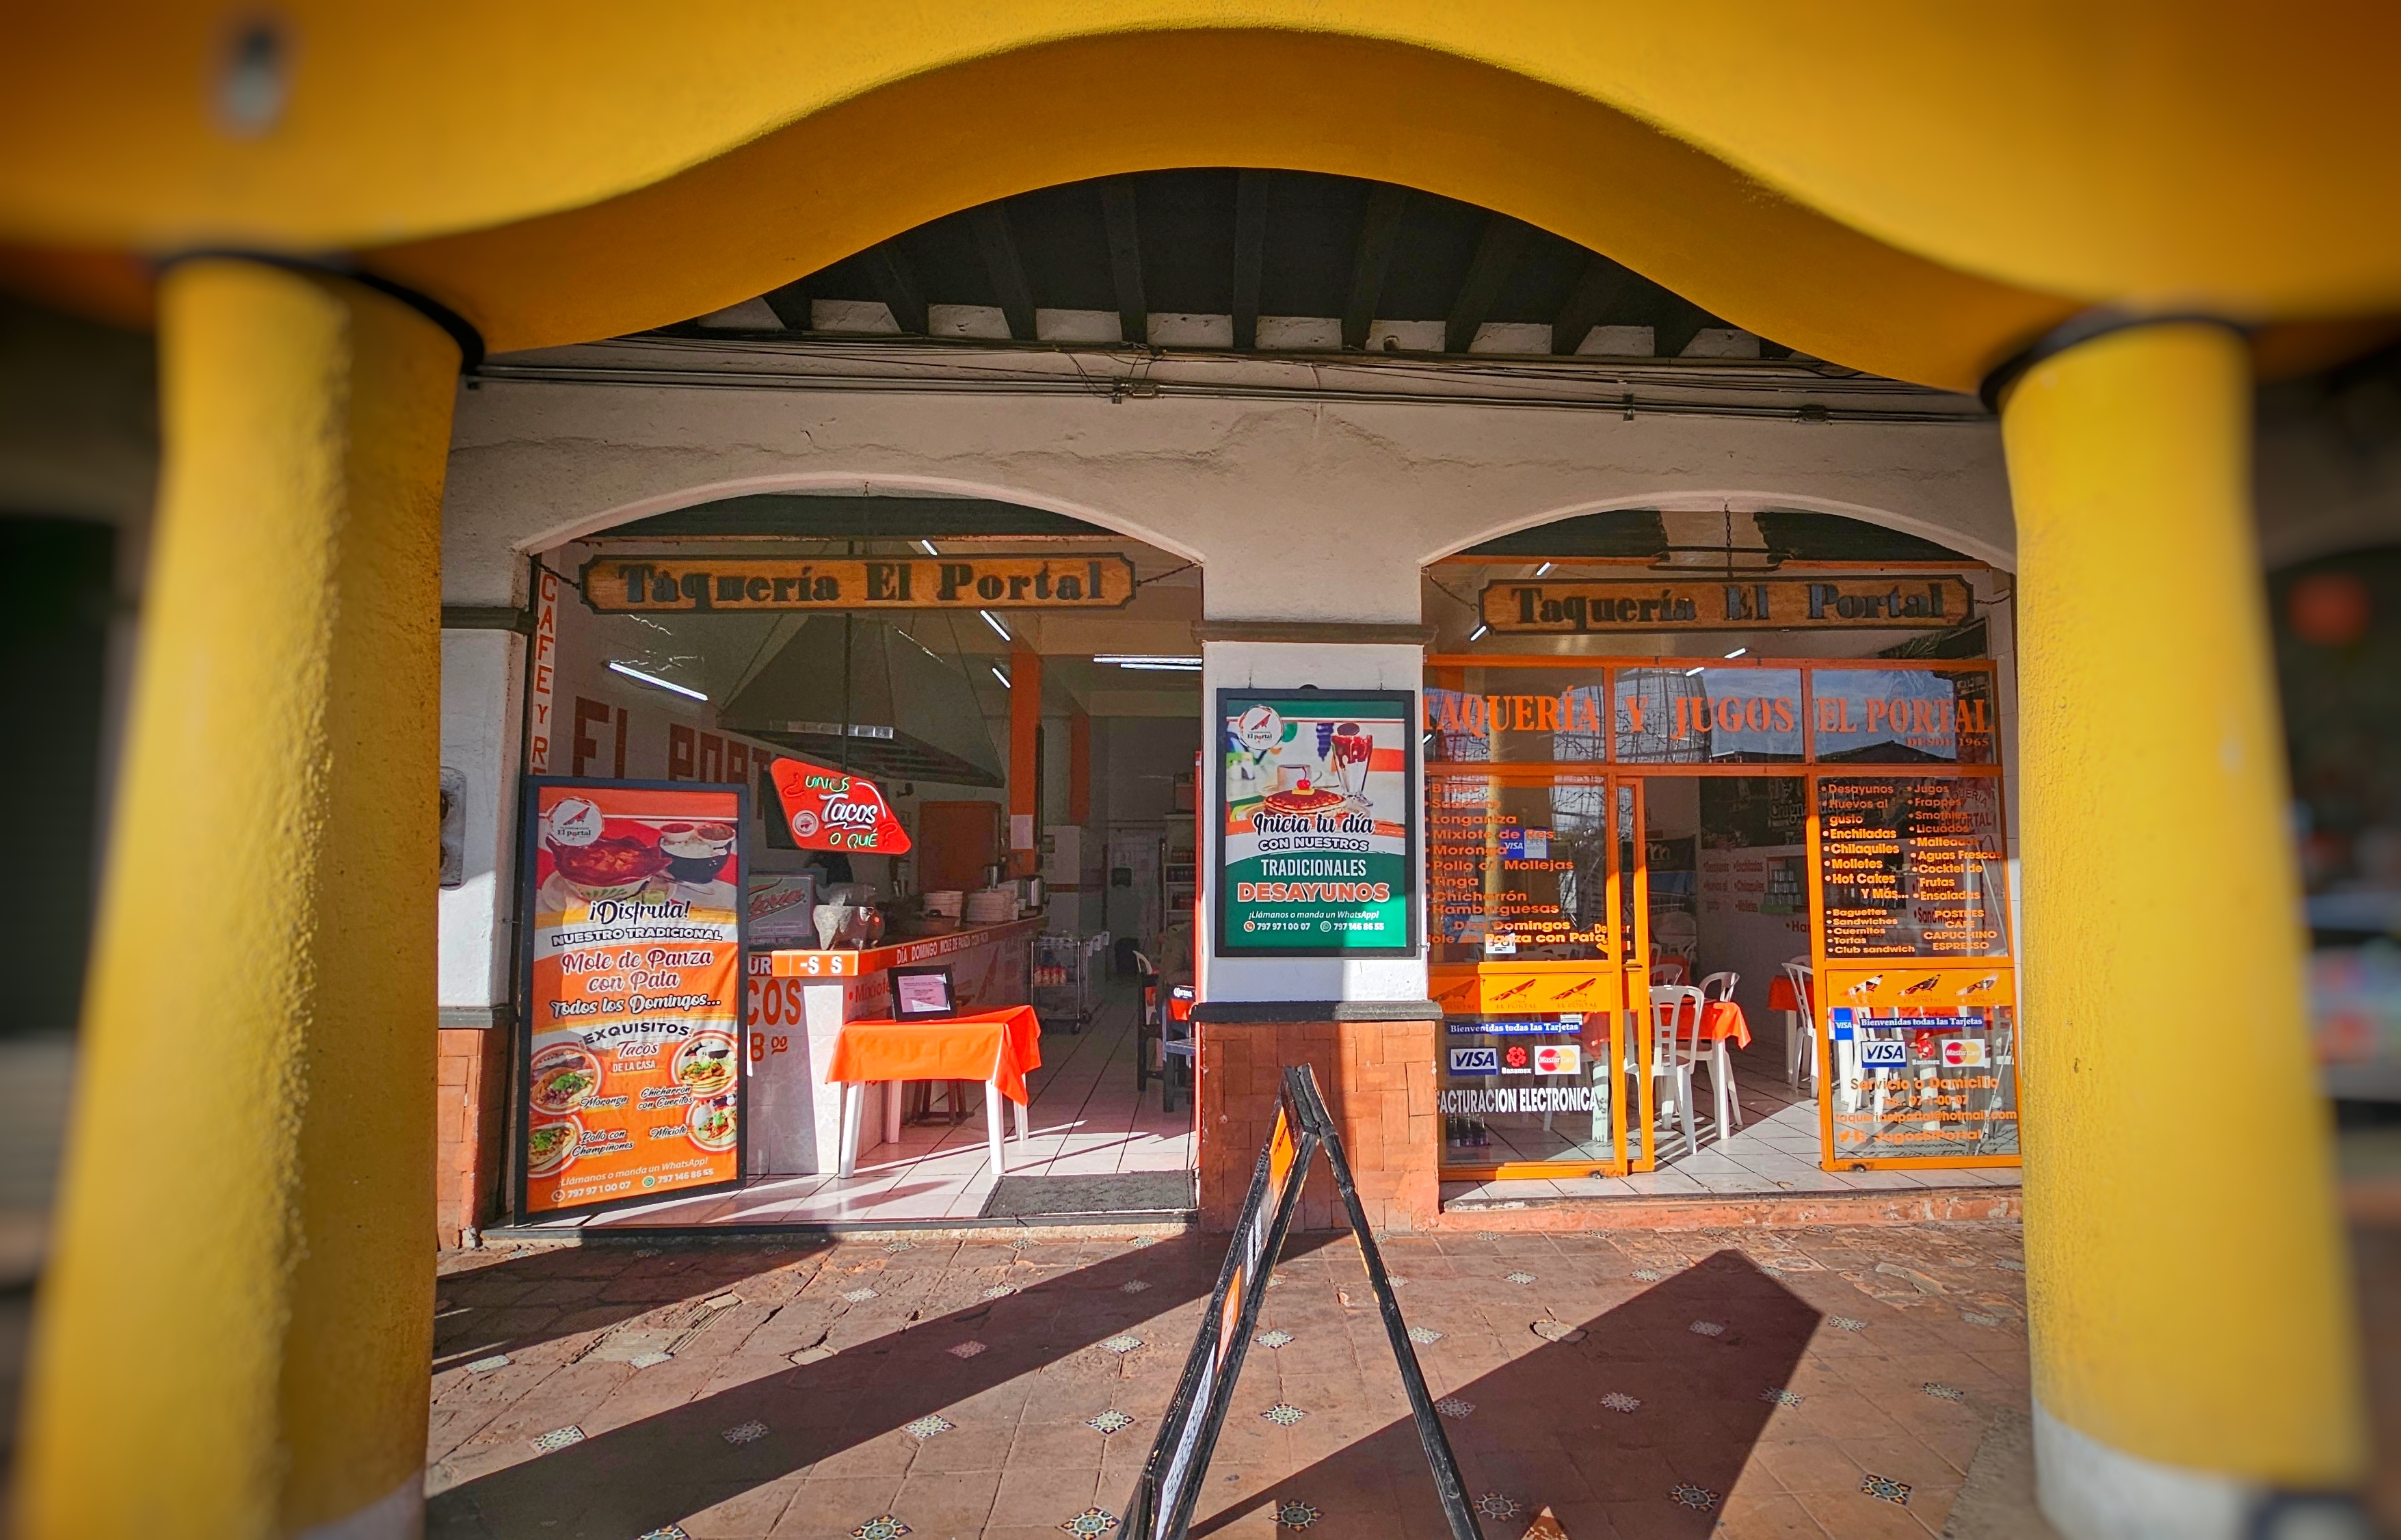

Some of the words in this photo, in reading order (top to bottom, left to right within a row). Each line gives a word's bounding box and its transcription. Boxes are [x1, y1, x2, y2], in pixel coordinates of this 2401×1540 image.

[618, 564, 841, 609] Taquería
[864, 563, 913, 600] El
[938, 561, 1103, 600] Portal
[1511, 588, 1696, 632] Taquería
[1725, 584, 1769, 620] El
[1808, 583, 1944, 619] Portal
[1623, 696, 1649, 732] Y
[1670, 695, 1794, 740] JUGOS
[1816, 698, 1857, 733] EL
[1866, 698, 1994, 734] PORTAL
[1959, 737, 1989, 747] 1965
[1829, 784, 1894, 795] Desayunos
[1914, 784, 1949, 795] Jugos
[819, 793, 878, 824] Tacos
[1829, 799, 1872, 808] Huevos
[1876, 799, 1888, 808] al
[1915, 798, 1961, 808] Frappes
[1253, 812, 1311, 836] Inicia
[1316, 813, 1336, 834] tu
[1342, 812, 1375, 834] día
[1433, 815, 1517, 825] Longaniza
[1829, 814, 1863, 826] gusto
[567, 829, 591, 837] portal
[1433, 829, 1492, 839] Mixiote
[1499, 829, 1521, 839] de
[1526, 829, 1554, 839] Res
[1830, 829, 1897, 839] Enchiladas
[1917, 824, 1969, 833] Licuados
[830, 832, 841, 845] O
[1258, 837, 1290, 851] CON
[1294, 836, 1370, 851] NUESTROS
[1917, 837, 1980, 847] Malteadas
[1433, 846, 1508, 858] Moronga
[1831, 844, 1899, 855] Chilaquiles
[1918, 851, 1955, 862] Aguas
[1958, 851, 2002, 860] Frescas
[1261, 859, 1366, 877] TRADICIONALES
[1433, 860, 1474, 871] Pollo
[1504, 860, 1574, 872] Mollejas
[1831, 859, 1883, 869] Molletes
[1919, 864, 1964, 873] Cocktel
[1968, 864, 1982, 873] de
[1433, 877, 1478, 888] Tinga
[1832, 873, 1855, 884] Hot
[1857, 873, 1896, 884] Cakes
[1920, 877, 1955, 887] Frutas
[1237, 882, 1390, 902] DESAYUNOS
[1433, 890, 1526, 901] Chicharrón
[1861, 888, 1870, 899] Y
[1920, 891, 1980, 901] Ensaladas
[589, 900, 691, 925] ¡Disfruta!
[1249, 911, 1289, 920] ¡Llámanos
[1433, 905, 1559, 916] Hamburguesas
[1833, 909, 1887, 918] Baguettes
[1494, 920, 1570, 933] Domingos
[1833, 918, 1898, 926] Sandwiches
[552, 929, 624, 947] NUESTRO
[626, 927, 723, 941] TRADICIONAL
[1536, 933, 1565, 942] con
[1924, 931, 1998, 940] CAPUCHINO
[1863, 945, 1915, 953] sandwich
[1933, 942, 1989, 951] ESPRESSO
[897, 946, 907, 964] DÍA
[912, 942, 937, 961] DOMINGO
[562, 951, 612, 974] Mole
[617, 952, 641, 968] de
[646, 948, 713, 967] Panza
[587, 975, 624, 992] con
[631, 971, 680, 990] Pata
[550, 1000, 598, 1018] Todos
[602, 998, 624, 1012] los
[1950, 1018, 1982, 1026] Tarjetas
[1450, 1024, 1504, 1033] Bienvenidas
[1505, 1024, 1528, 1032] todas
[1530, 1023, 1543, 1031] las
[1543, 1023, 1578, 1033] Tarjetas
[617, 1040, 659, 1059] Tacos
[1867, 1045, 1904, 1059] VISA
[1456, 1052, 1494, 1067] VISA
[613, 1063, 621, 1072] DE
[625, 1062, 633, 1070] LA
[637, 1061, 655, 1070] CASA
[1851, 1078, 1910, 1091] Servicio
[1929, 1075, 1999, 1089] Domicilio
[640, 1085, 692, 1098] Chicharrón
[581, 1096, 628, 1108] Moronga
[638, 1101, 653, 1110] con
[656, 1096, 693, 1108] Cueritos
[1520, 1087, 1600, 1112] ELECTRONICA
[581, 1131, 607, 1143] Pollo
[609, 1130, 626, 1139] con
[572, 1141, 633, 1158] Champiñones
[615, 1166, 647, 1178] manda
[657, 1175, 673, 1184] 797
[568, 1189, 584, 1198] 797
[585, 1186, 597, 1195] 97
[605, 1183, 618, 1192] 00
[619, 1181, 631, 1189] 07
